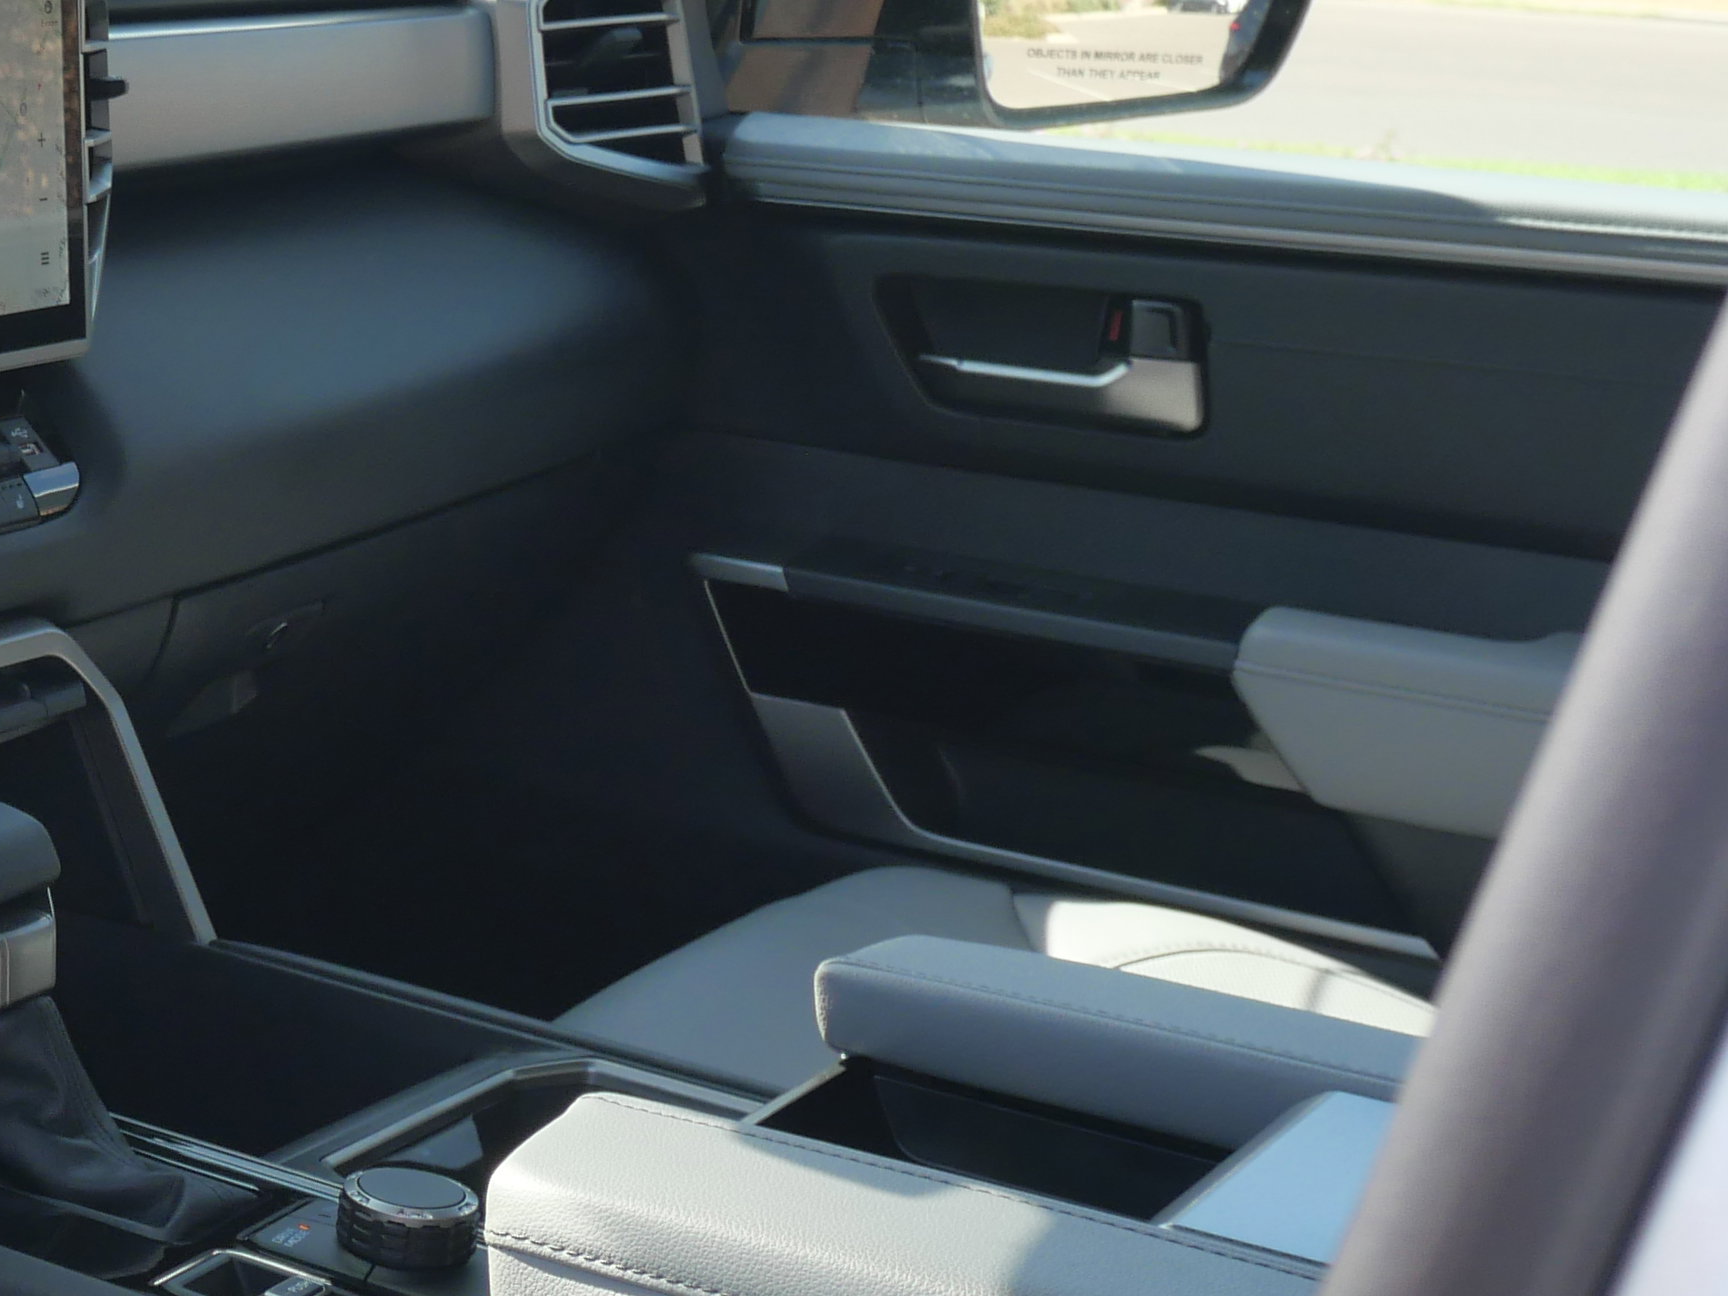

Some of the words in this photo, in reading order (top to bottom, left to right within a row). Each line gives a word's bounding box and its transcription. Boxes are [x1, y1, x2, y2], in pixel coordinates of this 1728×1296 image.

[1027, 48, 1077, 61] OBJECTS
[1080, 50, 1091, 61] IN
[1094, 51, 1135, 62] MIRROR
[1139, 52, 1159, 64] ARE
[1162, 54, 1203, 65] CLOSER
[1057, 67, 1084, 79] THAN
[1089, 69, 1115, 80] THEY
